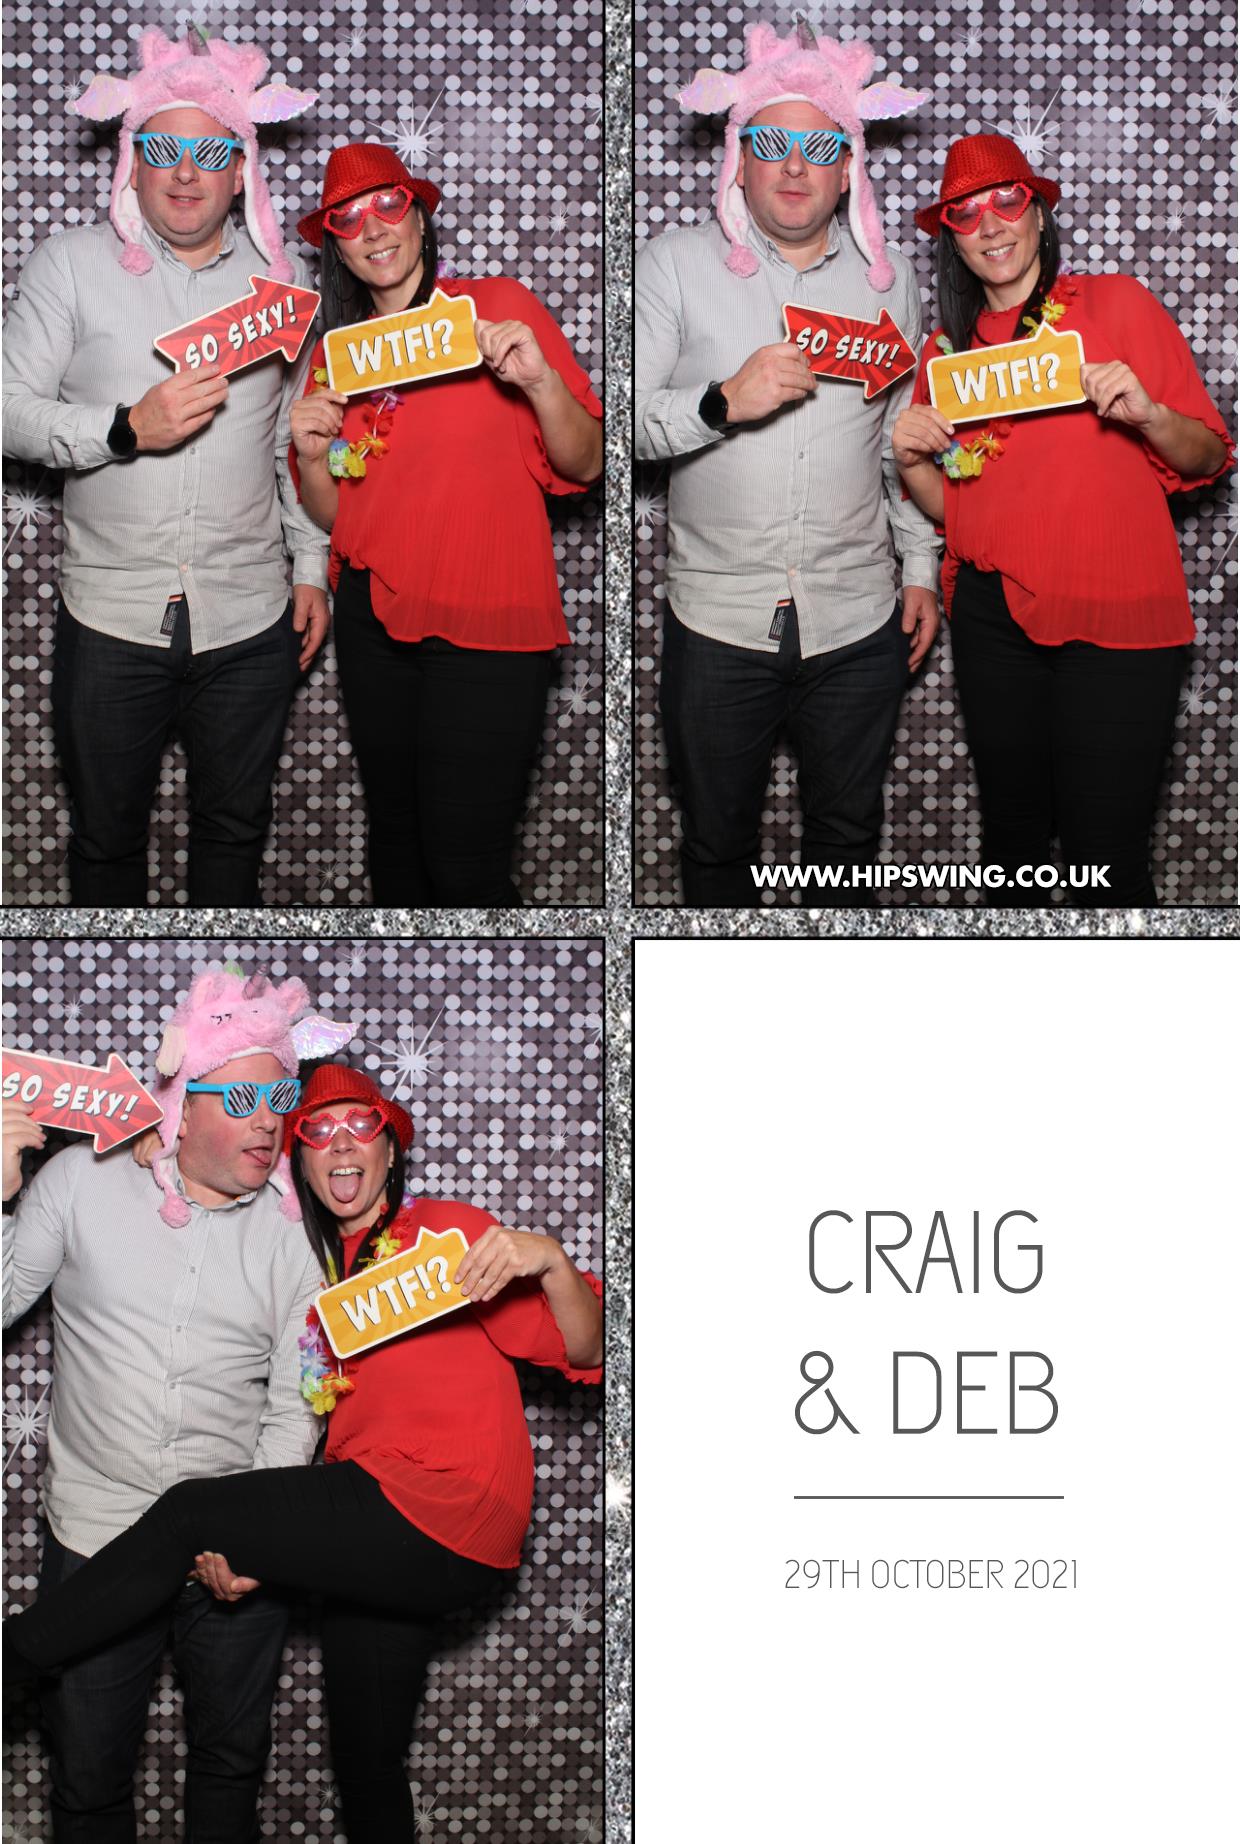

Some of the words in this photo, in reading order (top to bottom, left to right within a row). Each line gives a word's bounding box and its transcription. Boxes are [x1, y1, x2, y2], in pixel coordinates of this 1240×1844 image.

[184, 333, 219, 369] SO
[227, 294, 297, 351] SEXY!
[346, 318, 454, 376] WTF!?
[796, 326, 829, 355] SO
[835, 334, 900, 369] SEXY!
[950, 352, 1060, 405] WTF!?
[2, 1071, 43, 1103] SO
[52, 1081, 140, 1122] SEXY!
[340, 1255, 452, 1333] WTF!?
